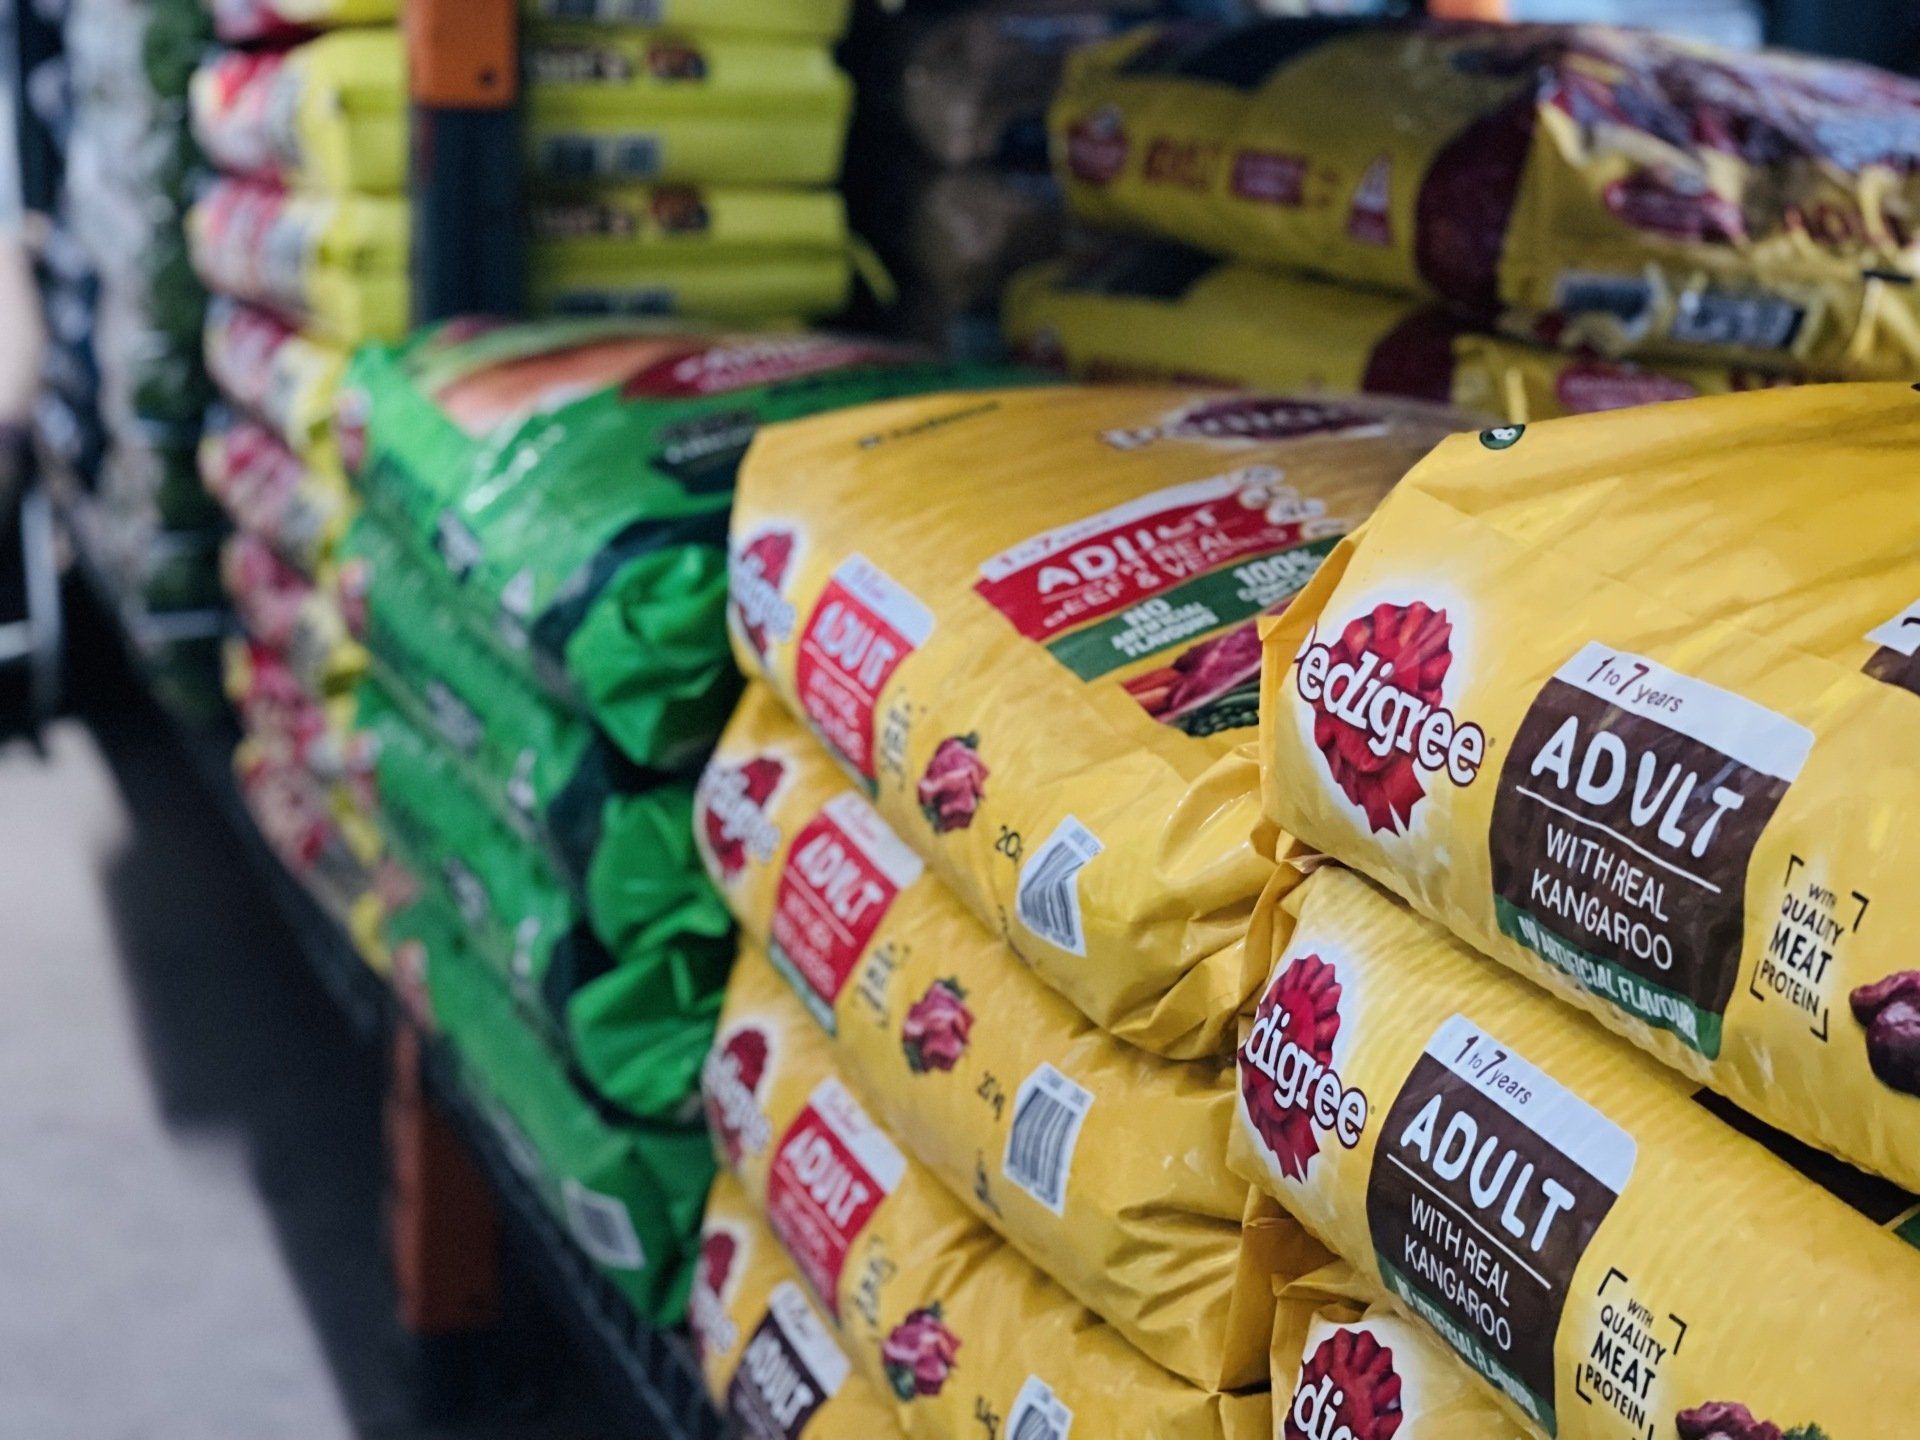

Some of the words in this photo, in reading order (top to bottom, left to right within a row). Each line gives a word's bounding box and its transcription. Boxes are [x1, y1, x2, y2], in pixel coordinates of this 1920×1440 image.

[1586, 656, 1616, 683] 1
[1603, 668, 1621, 687] to
[1616, 662, 1650, 696] 7
[1631, 683, 1684, 713] years
[1294, 619, 1486, 787] edigree
[1530, 715, 1745, 858] ADULT
[1546, 823, 1615, 885] WITH
[1611, 858, 1670, 923] REAL
[1808, 882, 1838, 911] WITH
[1530, 867, 1673, 971] KANGAROO
[1768, 921, 1833, 985] MEAT
[1759, 958, 1820, 1017] PROTEIN
[1243, 1002, 1369, 1150] digree
[1454, 1035, 1480, 1064] 1
[1467, 1053, 1483, 1071] to
[1476, 1050, 1508, 1079] 7
[1485, 1071, 1533, 1106] years
[1400, 1093, 1576, 1252] ADULT
[1411, 1192, 1462, 1259] WITH
[1462, 1236, 1511, 1308] REAL
[1403, 1233, 1513, 1351] KANGAROO
[1627, 1297, 1655, 1329] WITH
[1590, 1329, 1656, 1400] MEAT
[1600, 1304, 1667, 1366] QUALITY
[1584, 1363, 1646, 1431] PROTEIN
